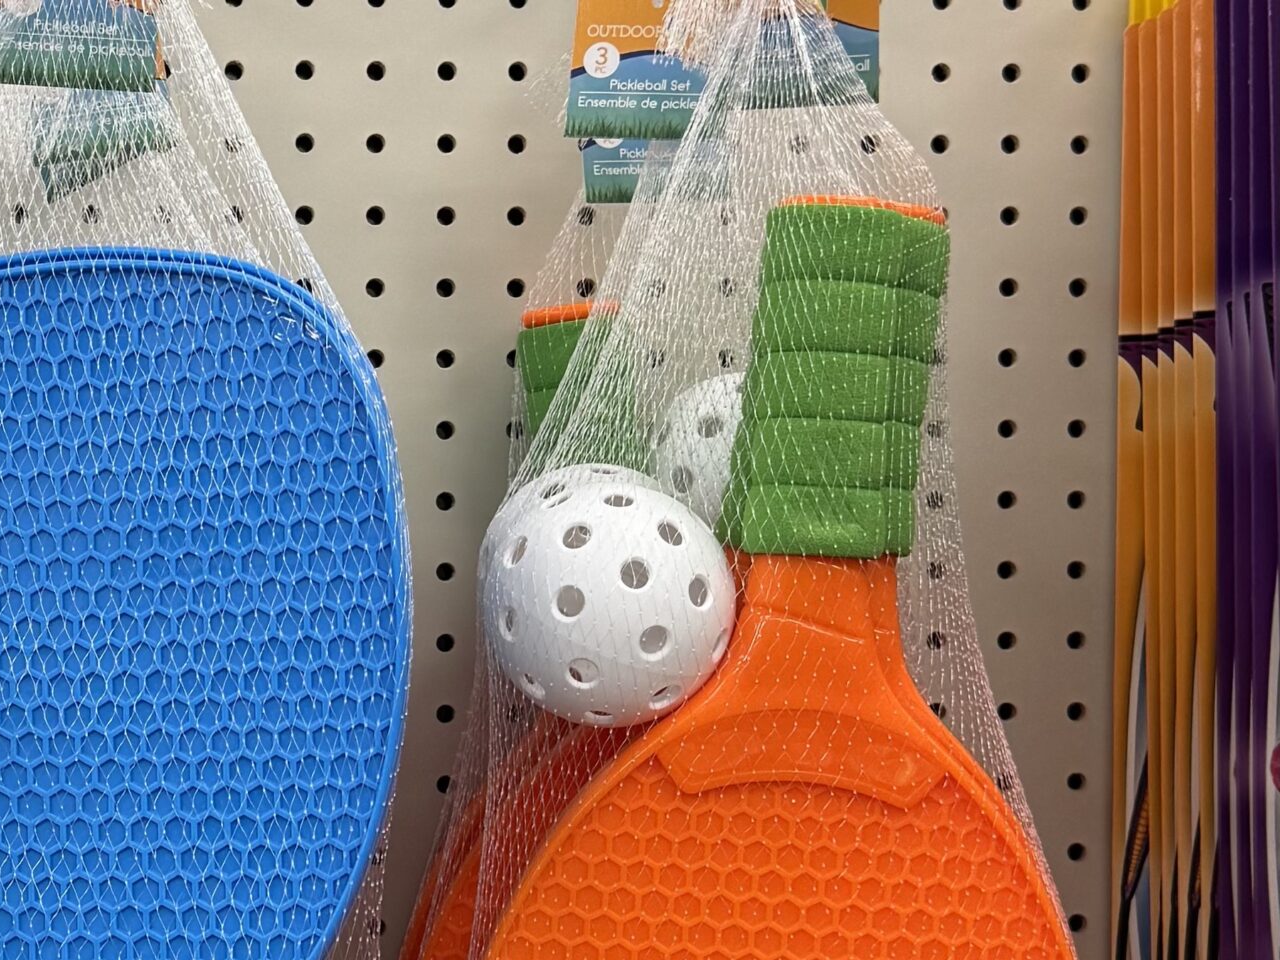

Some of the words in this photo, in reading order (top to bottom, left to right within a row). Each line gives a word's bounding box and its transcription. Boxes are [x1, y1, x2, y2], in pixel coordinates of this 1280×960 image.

[595, 46, 608, 65] 3
[609, 78, 667, 91] Pickleball
[670, 80, 691, 91] Set
[577, 95, 637, 109] Ensemble
[640, 98, 658, 109] de
[660, 97, 698, 112] pickle
